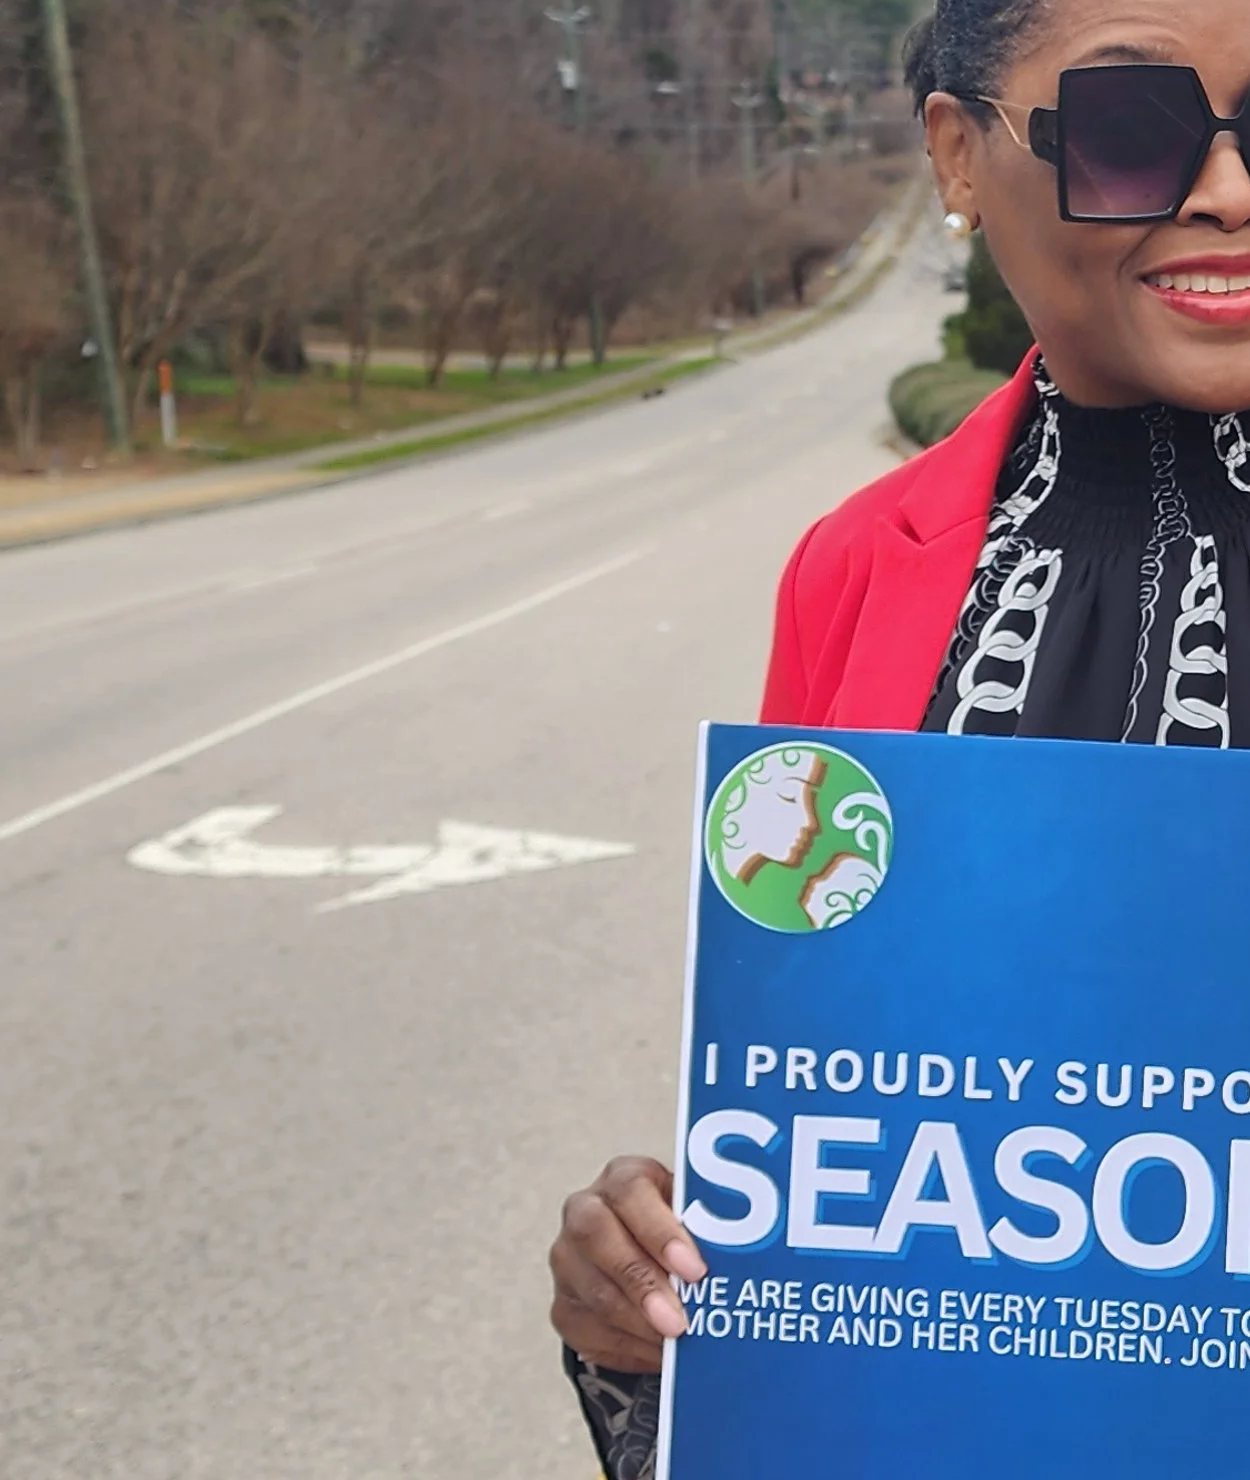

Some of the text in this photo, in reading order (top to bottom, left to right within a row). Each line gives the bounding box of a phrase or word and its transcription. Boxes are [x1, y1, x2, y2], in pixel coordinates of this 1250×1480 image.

[704, 1042, 718, 1086] I
[745, 1045, 1034, 1102] PROUDLY
[680, 1276, 729, 1306] WE
[735, 1279, 802, 1311] ARE
[811, 1283, 929, 1318] GIVING
[939, 1290, 1047, 1325] EVERY
[1054, 1297, 1212, 1335] TUESDAY
[827, 1316, 902, 1347] AND
[912, 1320, 979, 1352] HER
[989, 1326, 1171, 1366] CHILDREN.
